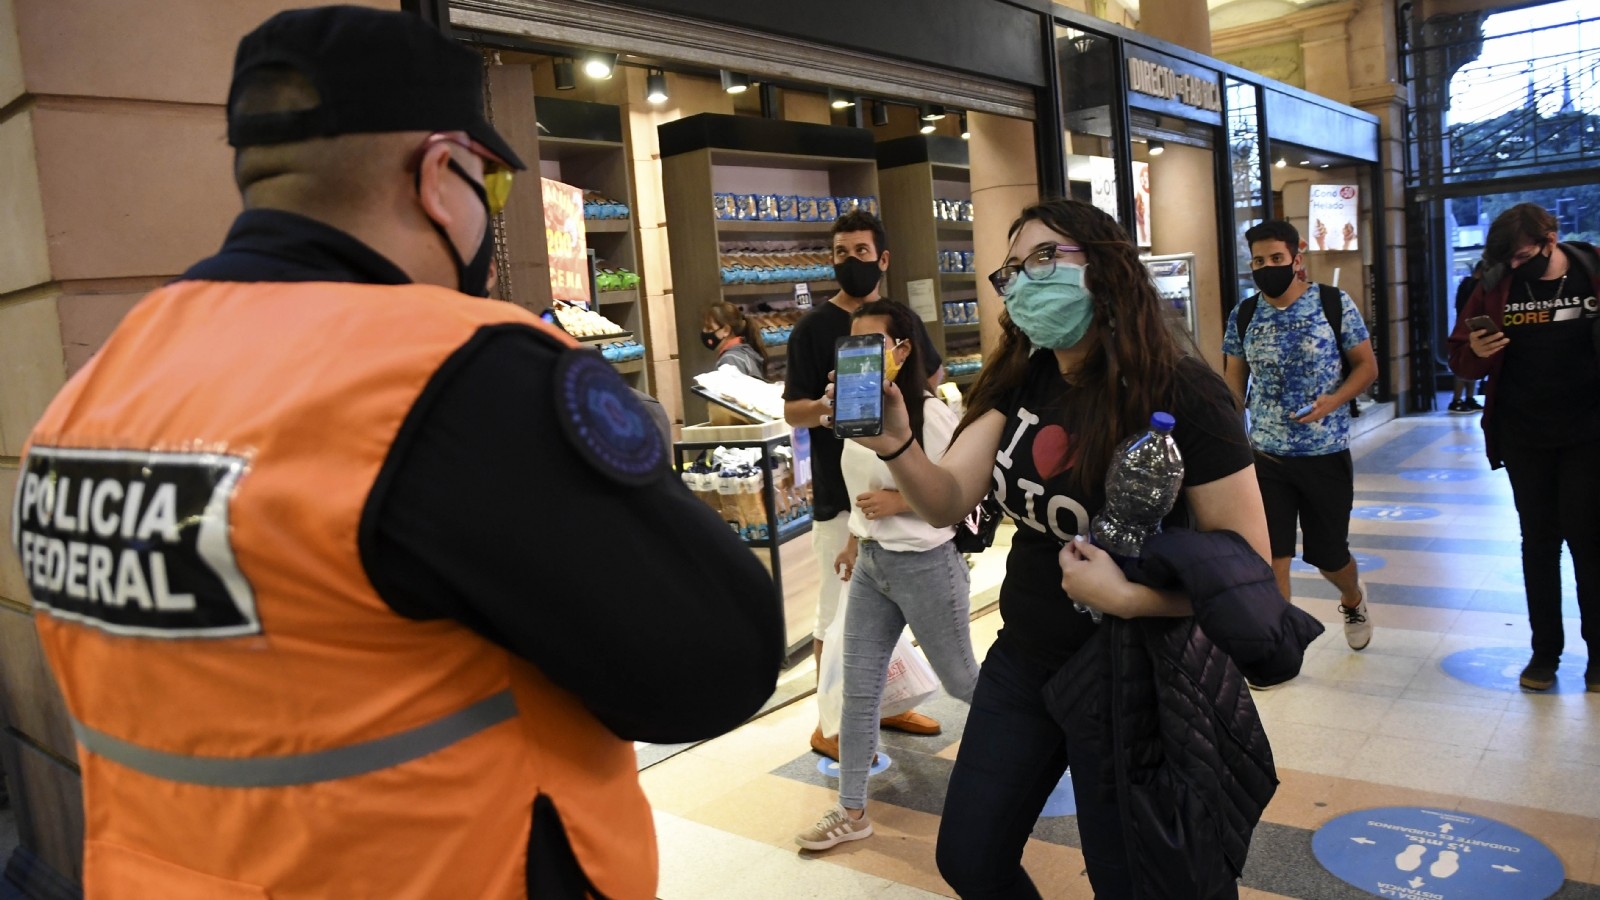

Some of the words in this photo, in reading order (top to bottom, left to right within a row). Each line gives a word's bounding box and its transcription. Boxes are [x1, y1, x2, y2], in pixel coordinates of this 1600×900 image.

[1128, 57, 1177, 99] DIRECTO
[1503, 296, 1582, 313] ORIGINALS
[1503, 310, 1551, 327] CORE
[22, 472, 182, 543] POLICIA
[22, 531, 196, 612] FEDERAL
[1367, 820, 1437, 838] CUIDARNOS
[1439, 833, 1455, 842] ES
[1457, 836, 1521, 853] CUIDARTE
[1377, 881, 1444, 900] DISTANCIA
[1379, 888, 1396, 896] LA
